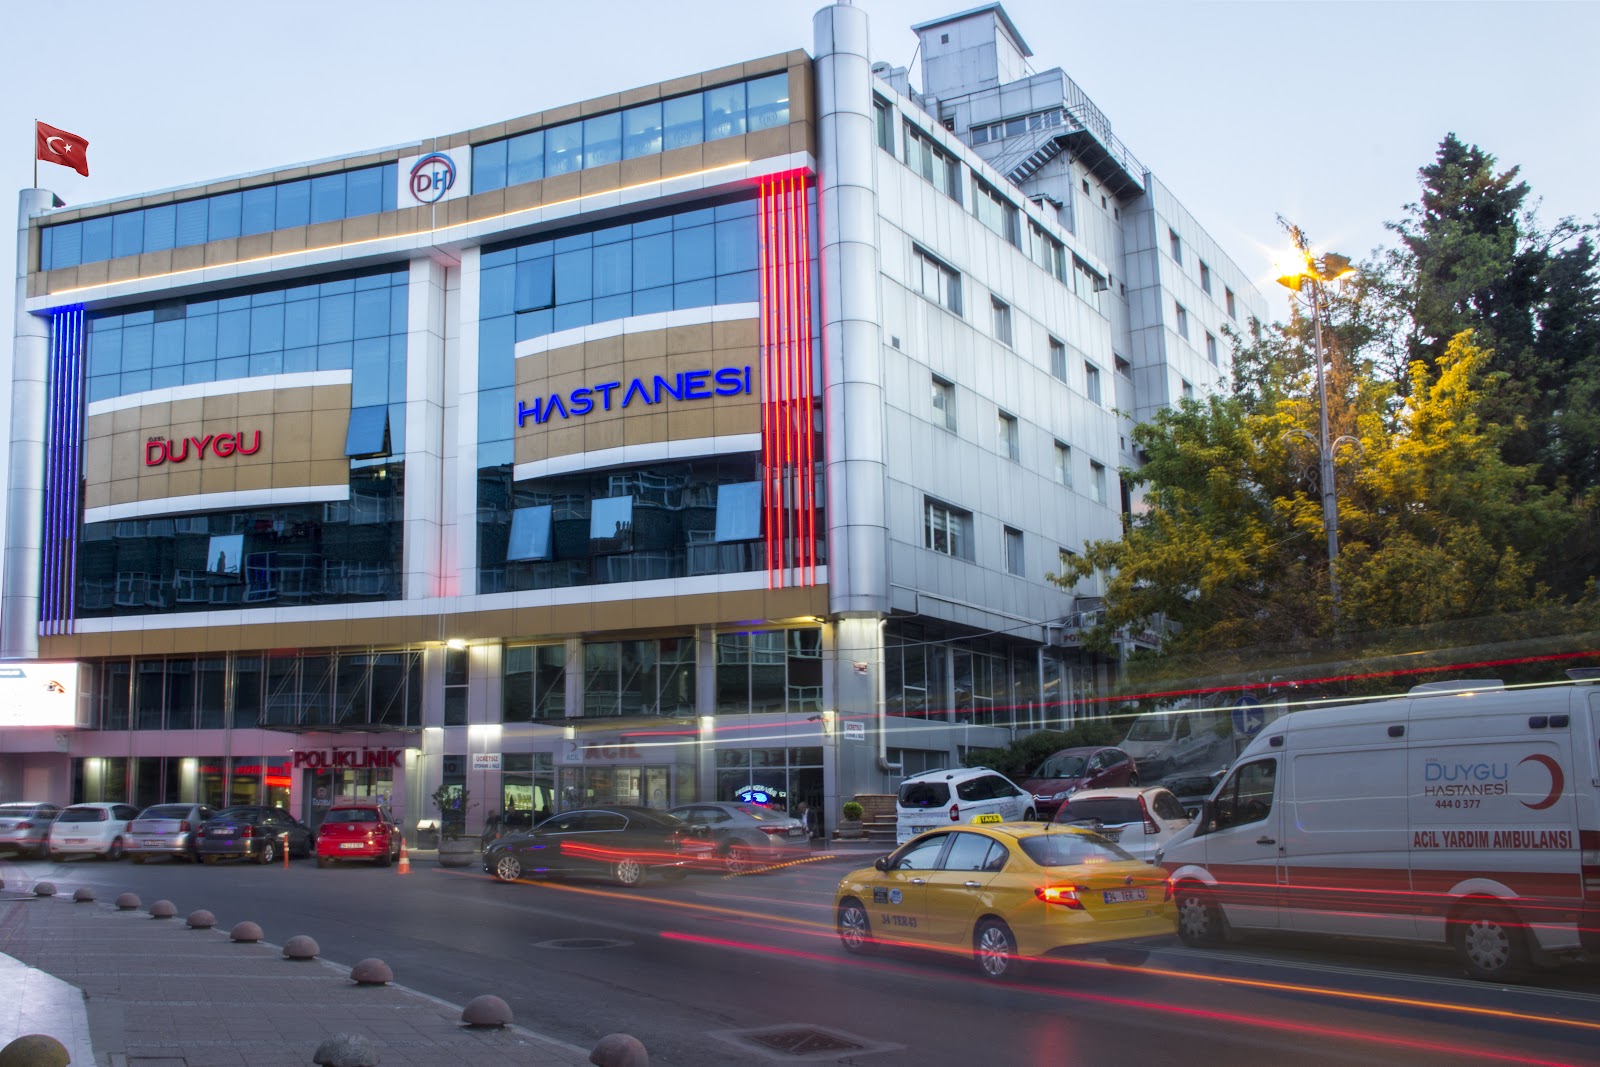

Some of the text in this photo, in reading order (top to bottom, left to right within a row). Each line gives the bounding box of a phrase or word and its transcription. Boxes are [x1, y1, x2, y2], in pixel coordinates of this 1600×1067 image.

[518, 366, 750, 427] HASTANESİ
[145, 430, 261, 466] DUYGU
[294, 747, 403, 768] POLİKLİNİK
[1425, 763, 1508, 781] DUYGU
[1425, 780, 1508, 797] HASTANESİ
[1435, 800, 1481, 809] 444 0 377
[1442, 831, 1490, 848] YARDIM
[1493, 831, 1573, 849] AMBULANSI
[1108, 889, 1146, 902] 34 TER 43
[882, 914, 917, 928] 34 TER 43
